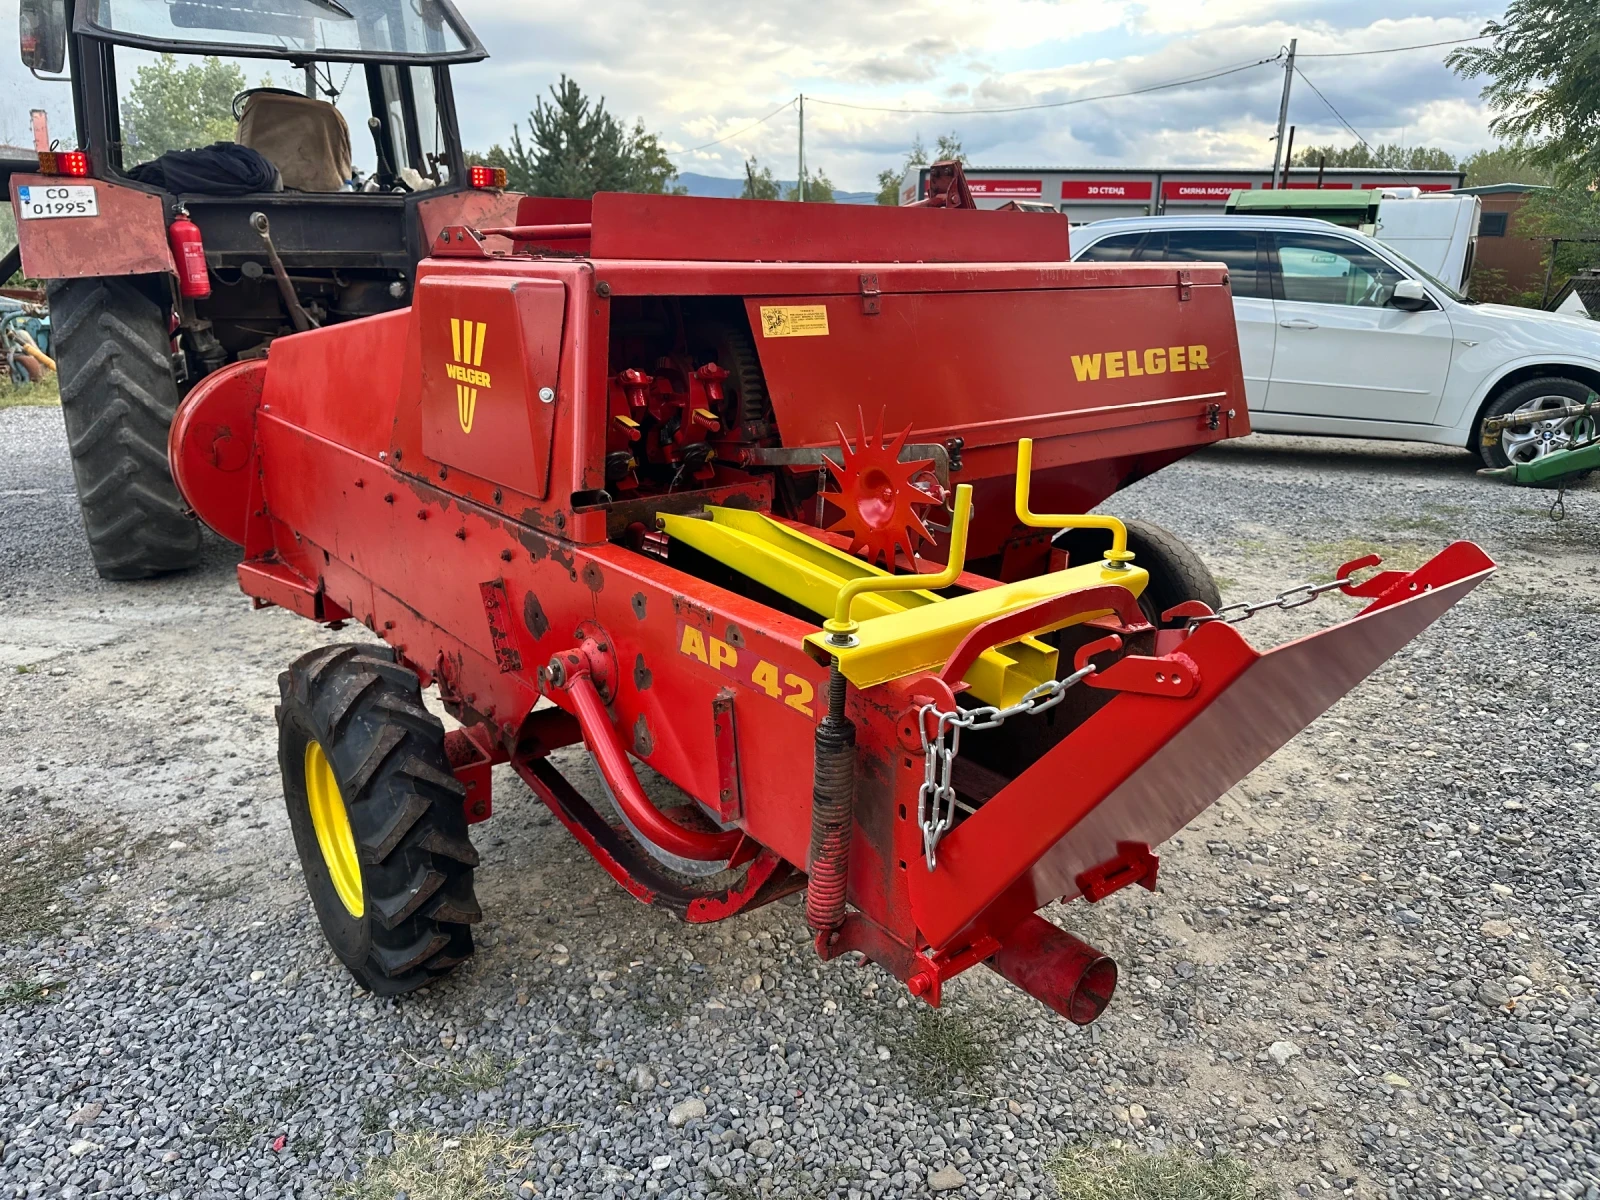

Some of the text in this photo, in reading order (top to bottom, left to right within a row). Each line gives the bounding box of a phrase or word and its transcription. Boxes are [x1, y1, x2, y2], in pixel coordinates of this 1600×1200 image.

[46, 188, 69, 199] CO
[1087, 186, 1125, 196] 3D СТЕНД
[1179, 187, 1206, 195] СМЯНА
[33, 202, 86, 215] 01995
[1070, 345, 1210, 382] WELGER
[445, 363, 492, 388] WELGER
[680, 624, 814, 718] AP 42
